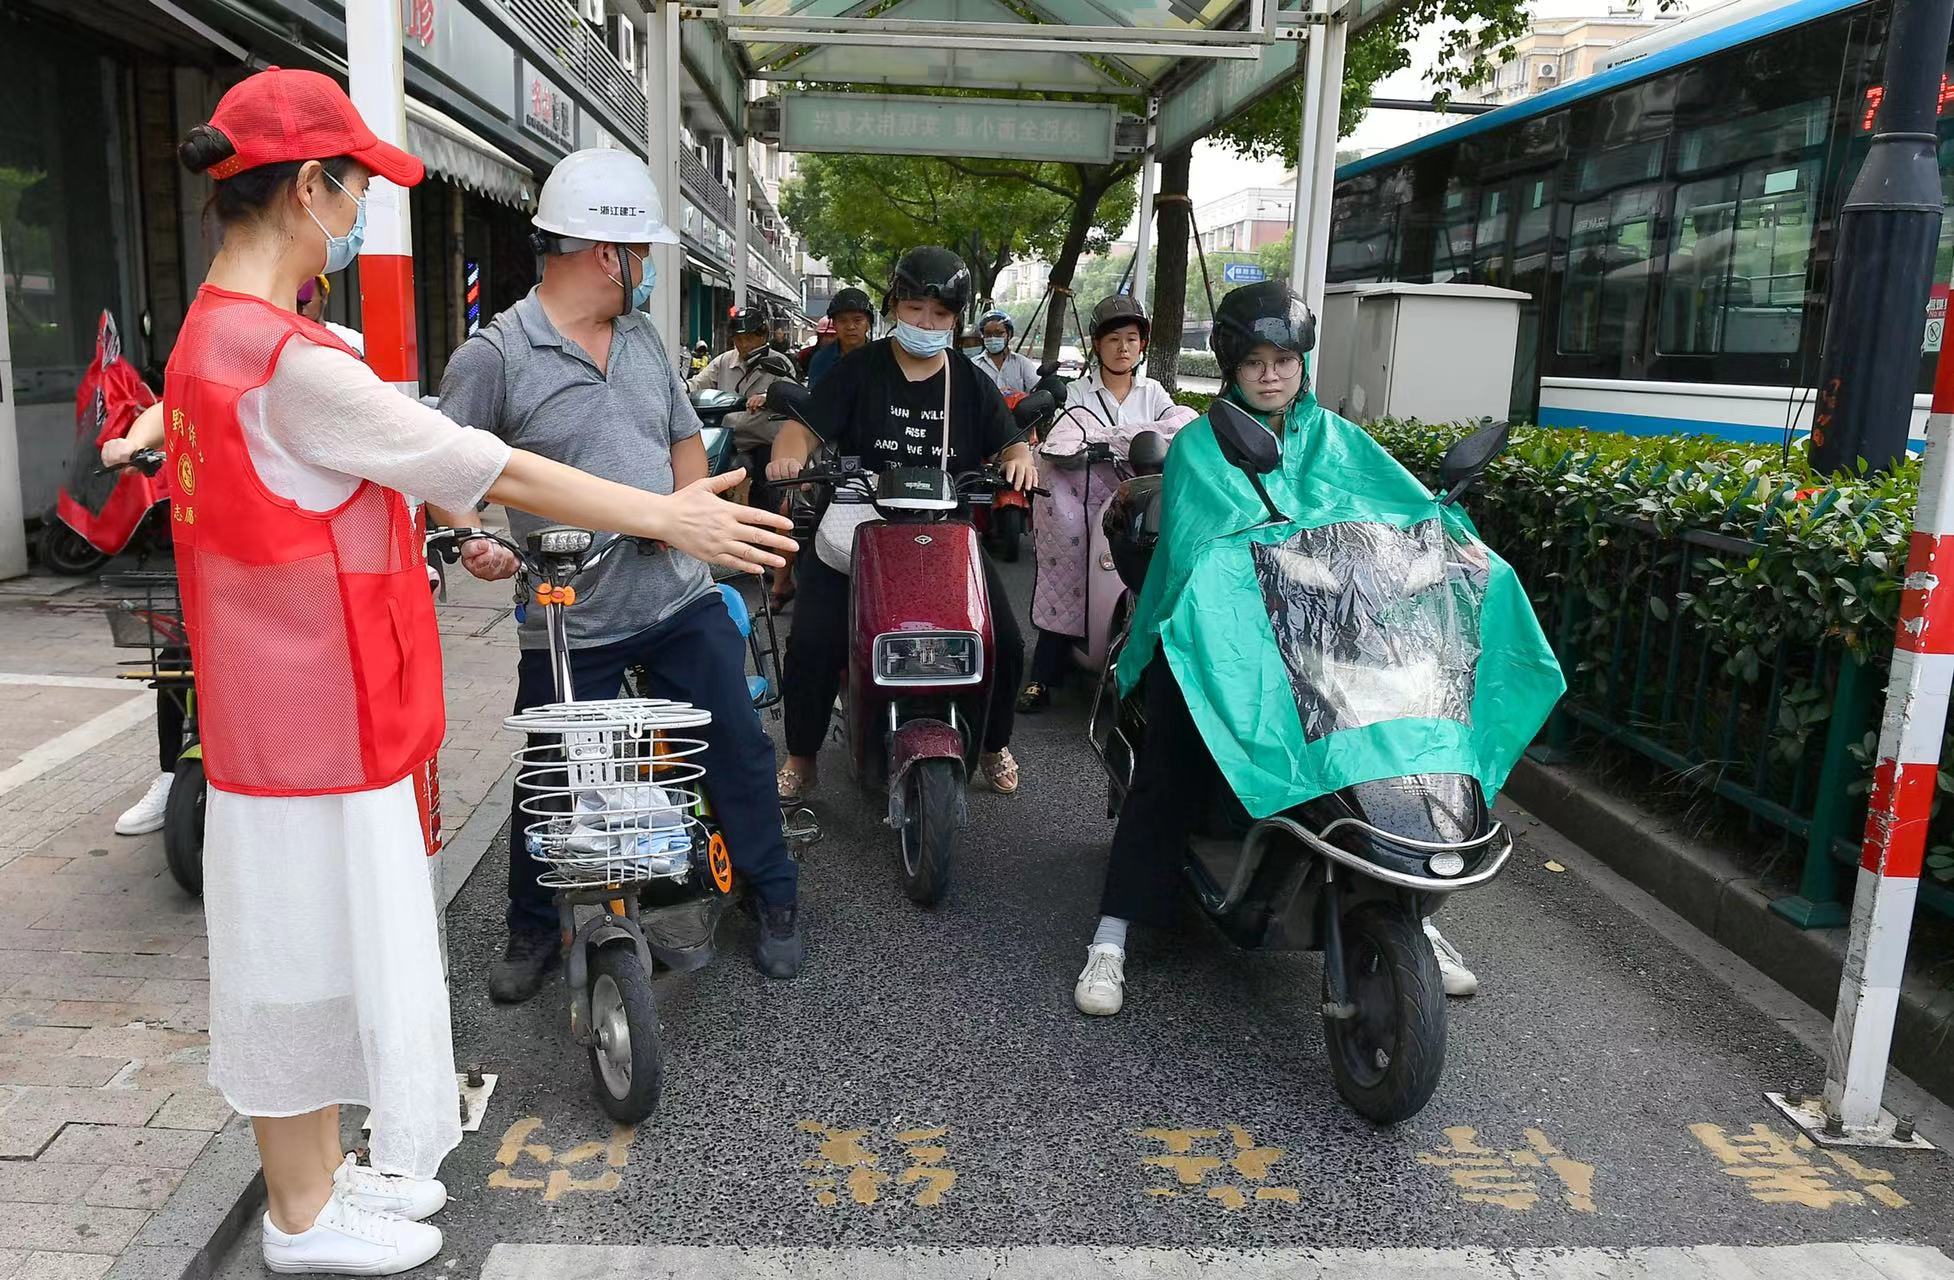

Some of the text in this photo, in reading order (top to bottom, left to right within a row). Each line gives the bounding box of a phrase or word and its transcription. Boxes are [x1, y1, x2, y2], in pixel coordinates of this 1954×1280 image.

[600, 205, 637, 217] 浙江建工
[905, 426, 926, 438] RISE
[874, 439, 899, 451] AND
[907, 444, 923, 455] WE
